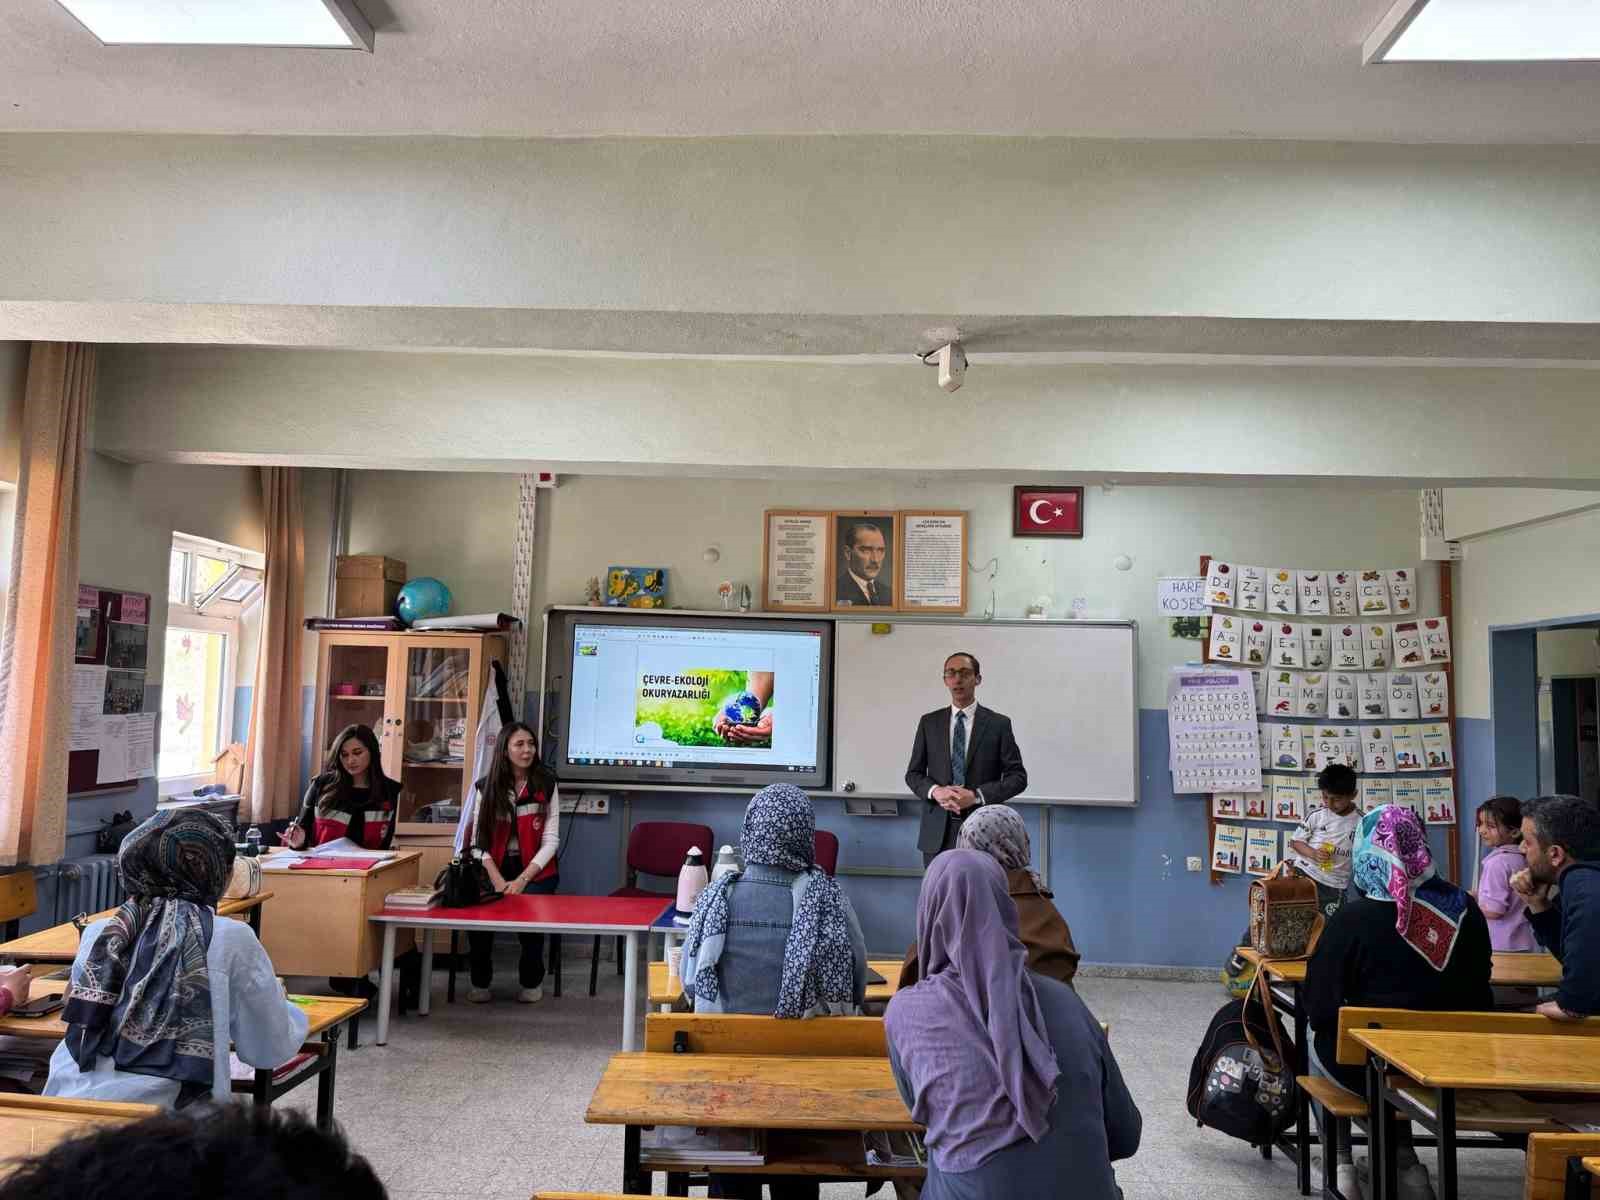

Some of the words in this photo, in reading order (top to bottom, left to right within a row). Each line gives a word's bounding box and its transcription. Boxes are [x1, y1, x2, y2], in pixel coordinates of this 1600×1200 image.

[1212, 577, 1221, 587] D
[1243, 582, 1251, 591] Z
[1304, 585, 1311, 596] B
[1217, 631, 1225, 641] A
[1247, 634, 1257, 647] N
[1279, 638, 1288, 648] E
[643, 674, 709, 687] ÇEVRE-EKOLOJİ
[642, 688, 711, 699] OKURYAZARLIĞI
[1303, 687, 1313, 698] M
[1424, 689, 1432, 699] Y
[1278, 740, 1287, 751] F
[1369, 742, 1376, 752] P
